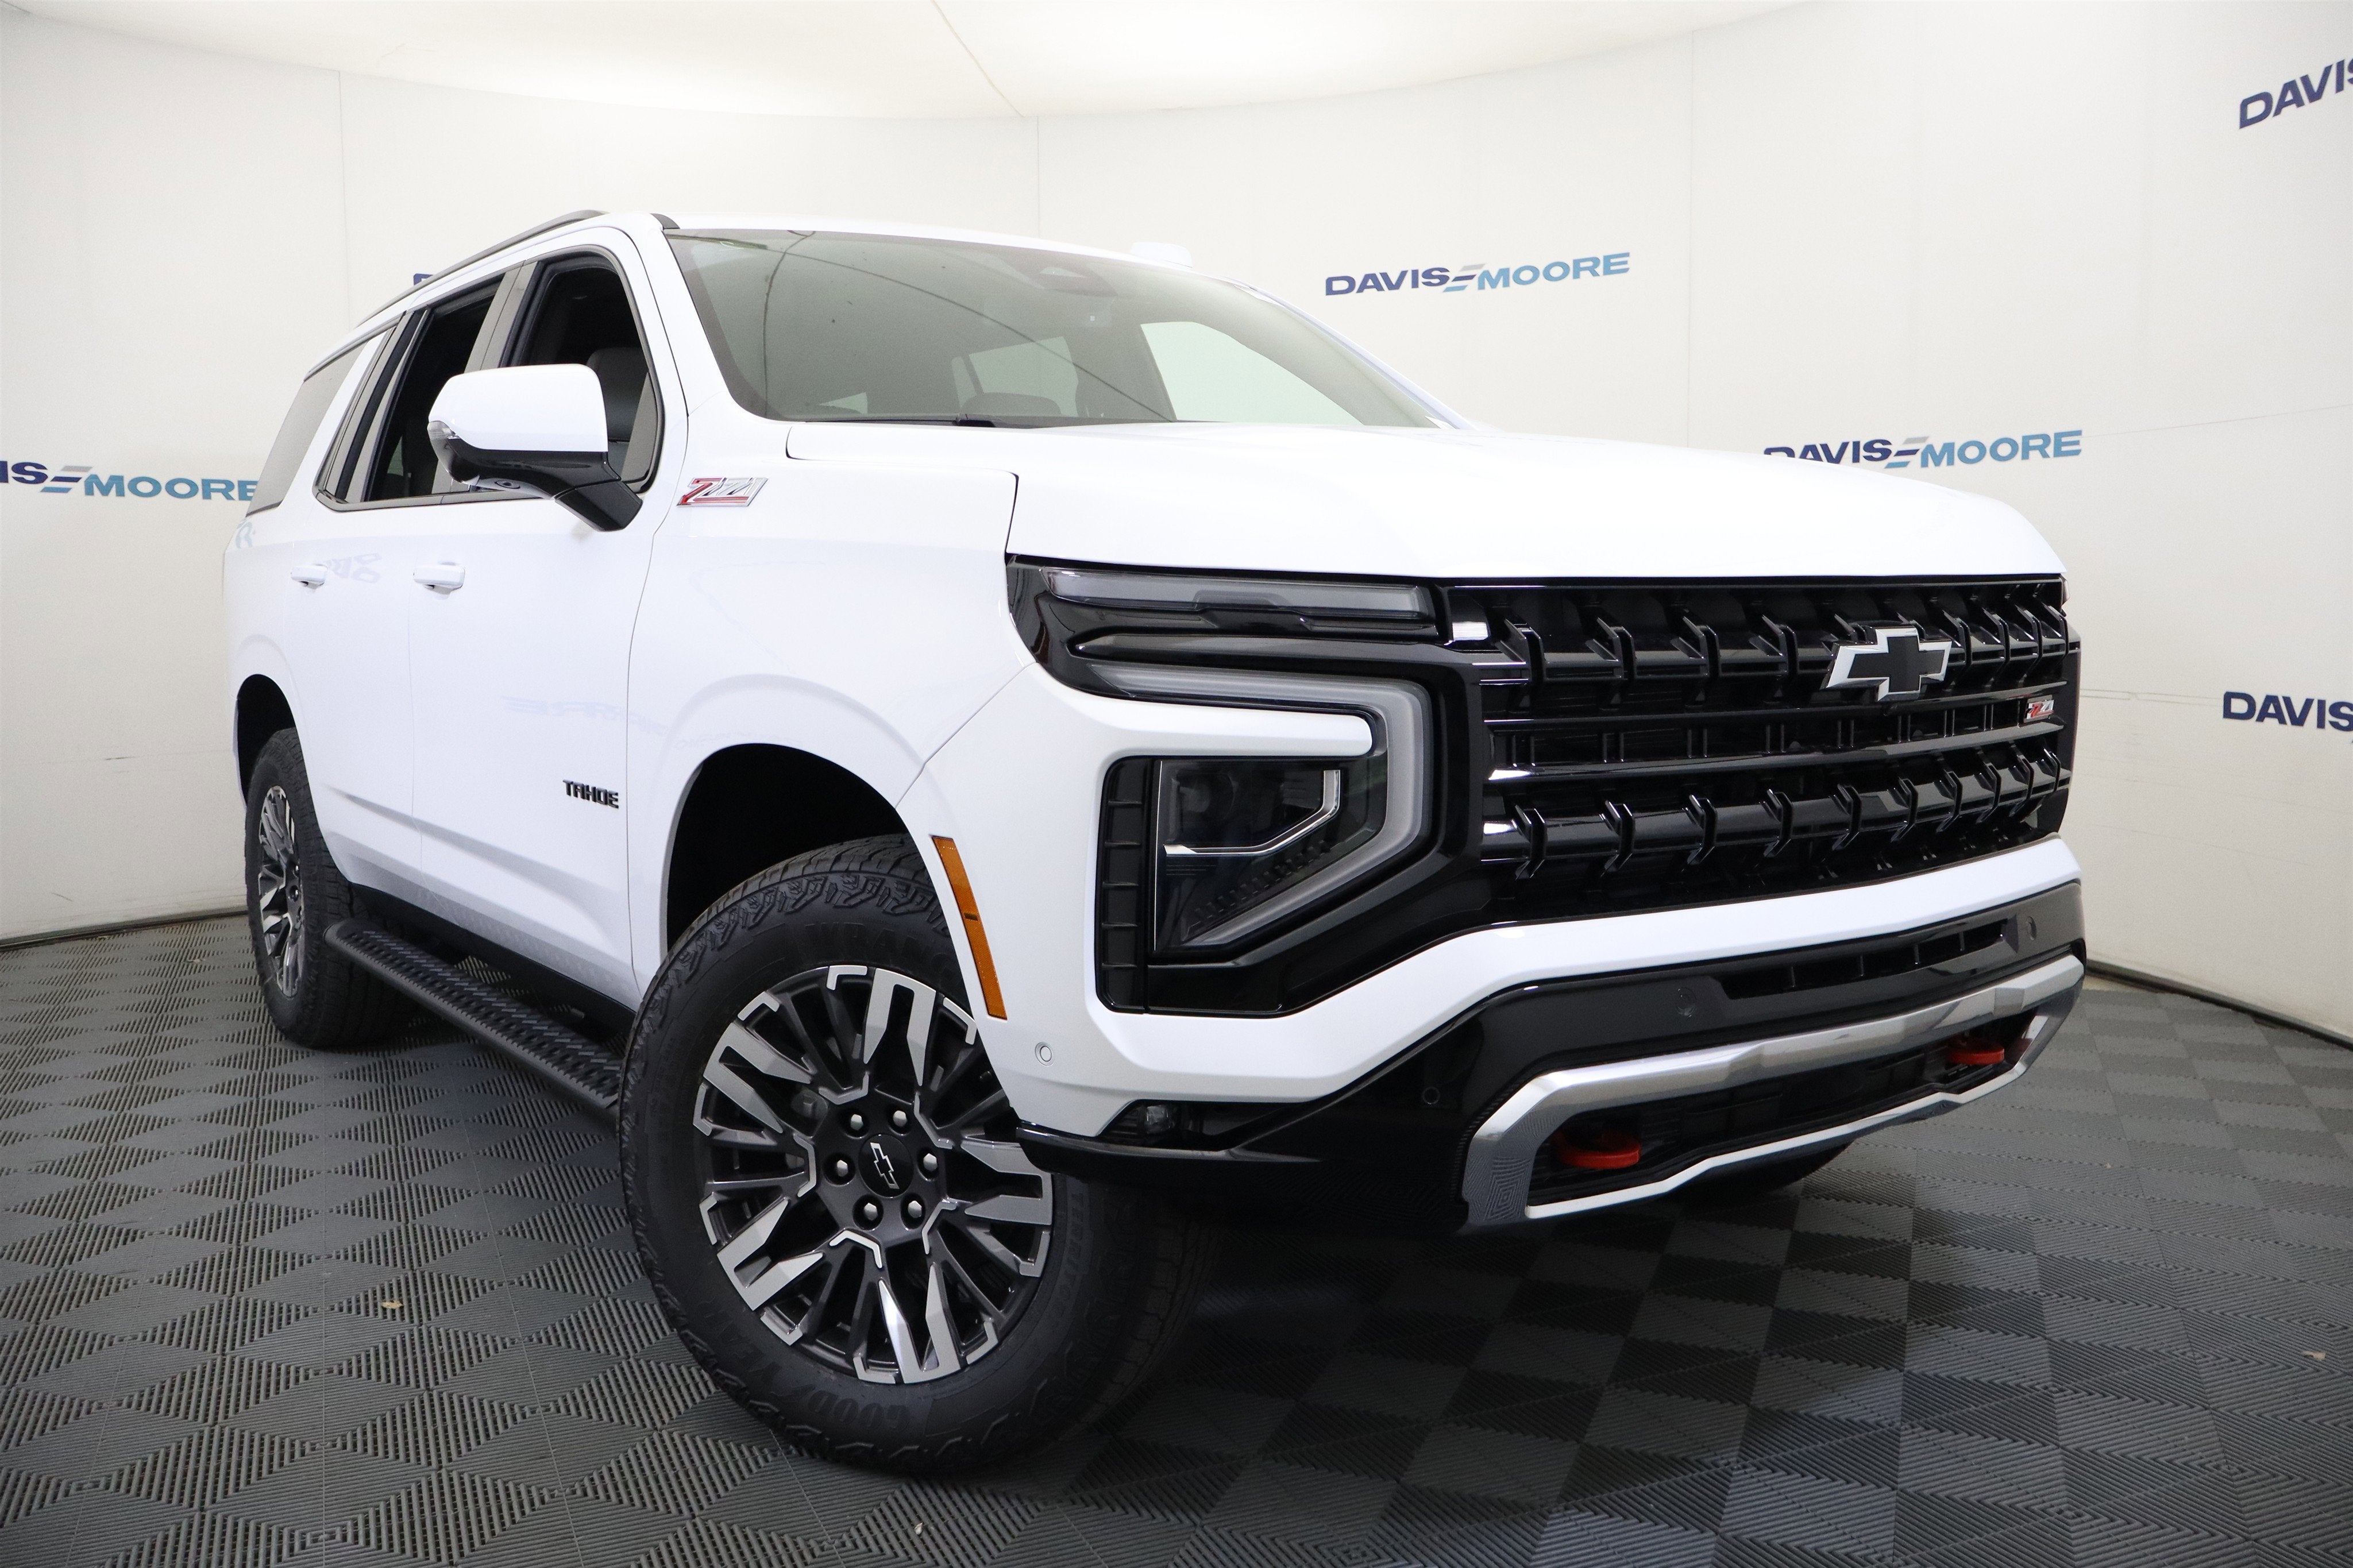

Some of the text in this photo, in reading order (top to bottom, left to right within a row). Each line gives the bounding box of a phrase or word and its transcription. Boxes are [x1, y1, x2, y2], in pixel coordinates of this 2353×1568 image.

[2239, 59, 2353, 129] DAVI
[1325, 252, 1630, 295] DAVIS MOORE
[1920, 430, 2082, 468] MOORE
[2223, 691, 2353, 731] DAVIS
[562, 779, 619, 809] TAHOE
